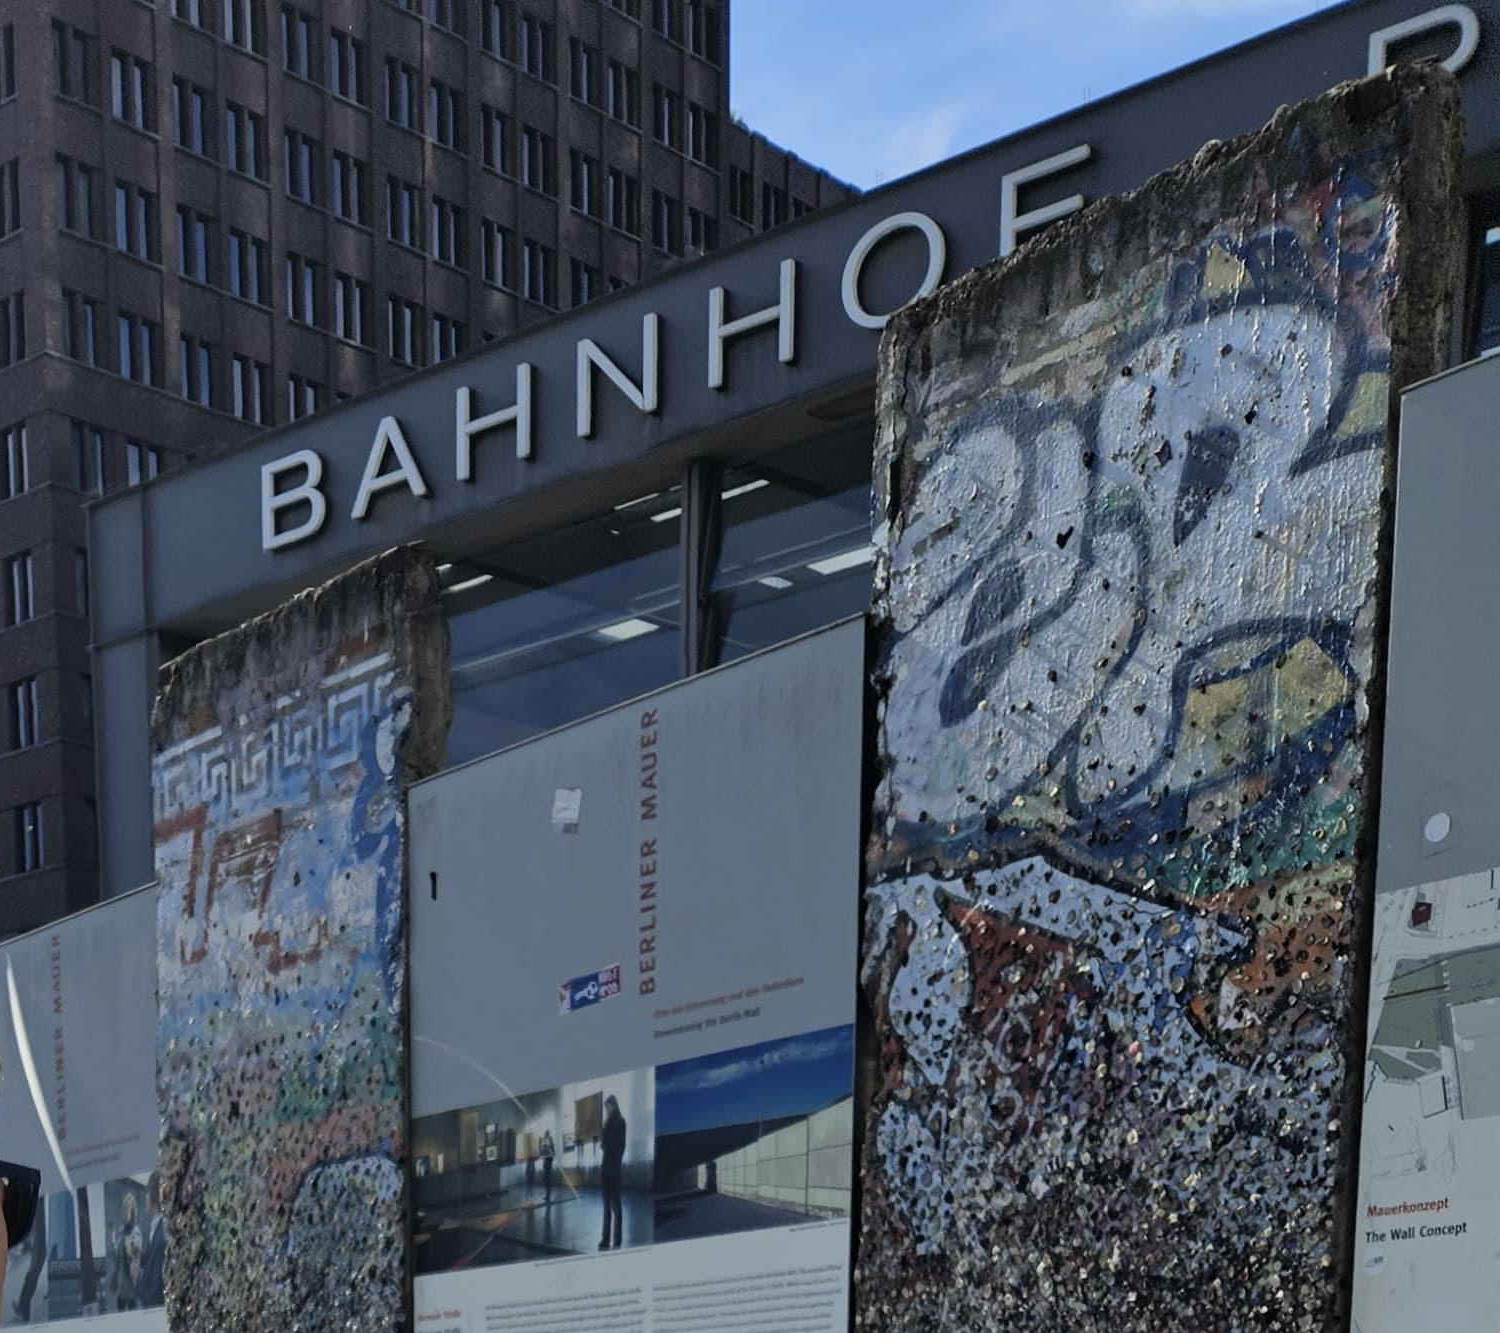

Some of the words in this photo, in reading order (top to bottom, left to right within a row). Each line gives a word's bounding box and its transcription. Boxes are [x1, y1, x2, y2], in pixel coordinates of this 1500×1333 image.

[260, 144, 1092, 553] BAHNHOF
[641, 708, 658, 821] MAUER
[639, 837, 657, 996] BERLINER
[51, 933, 64, 1014] MAUER
[1365, 1230, 1386, 1244] The
[1390, 1227, 1416, 1241] Wall
[1419, 1221, 1468, 1238] Concept
[1366, 1197, 1449, 1218] Mauerkonzept
